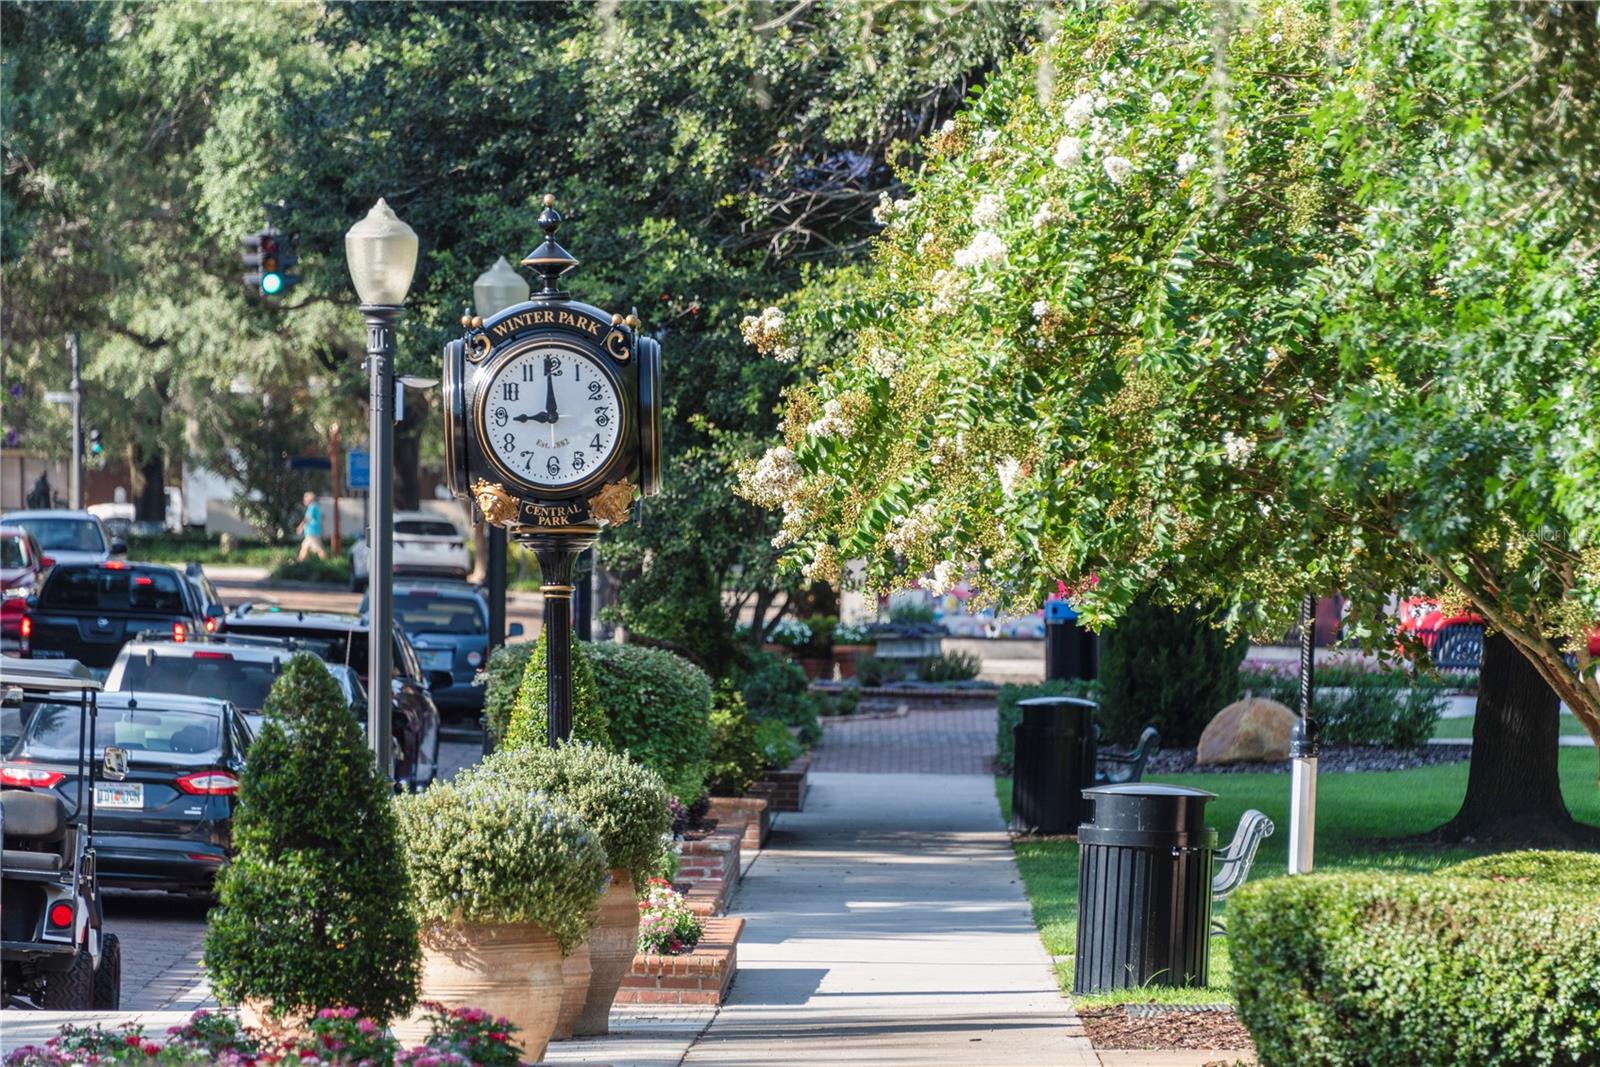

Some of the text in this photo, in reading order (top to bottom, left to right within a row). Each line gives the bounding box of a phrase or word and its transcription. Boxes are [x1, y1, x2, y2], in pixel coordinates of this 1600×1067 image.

[492, 310, 601, 337] WINTER PARK
[523, 364, 534, 382] 11
[544, 357, 563, 376] 12
[575, 364, 580, 382] 1
[503, 382, 519, 402] 10
[588, 381, 603, 401] 2
[495, 406, 509, 427] 9
[594, 406, 610, 427] 3
[504, 433, 516, 453] 8
[589, 433, 604, 452] 4
[520, 451, 535, 470] 7
[546, 456, 561, 477] 6
[572, 451, 585, 470] 5
[525, 504, 582, 517] CENTRAL
[538, 516, 570, 526] PARK
